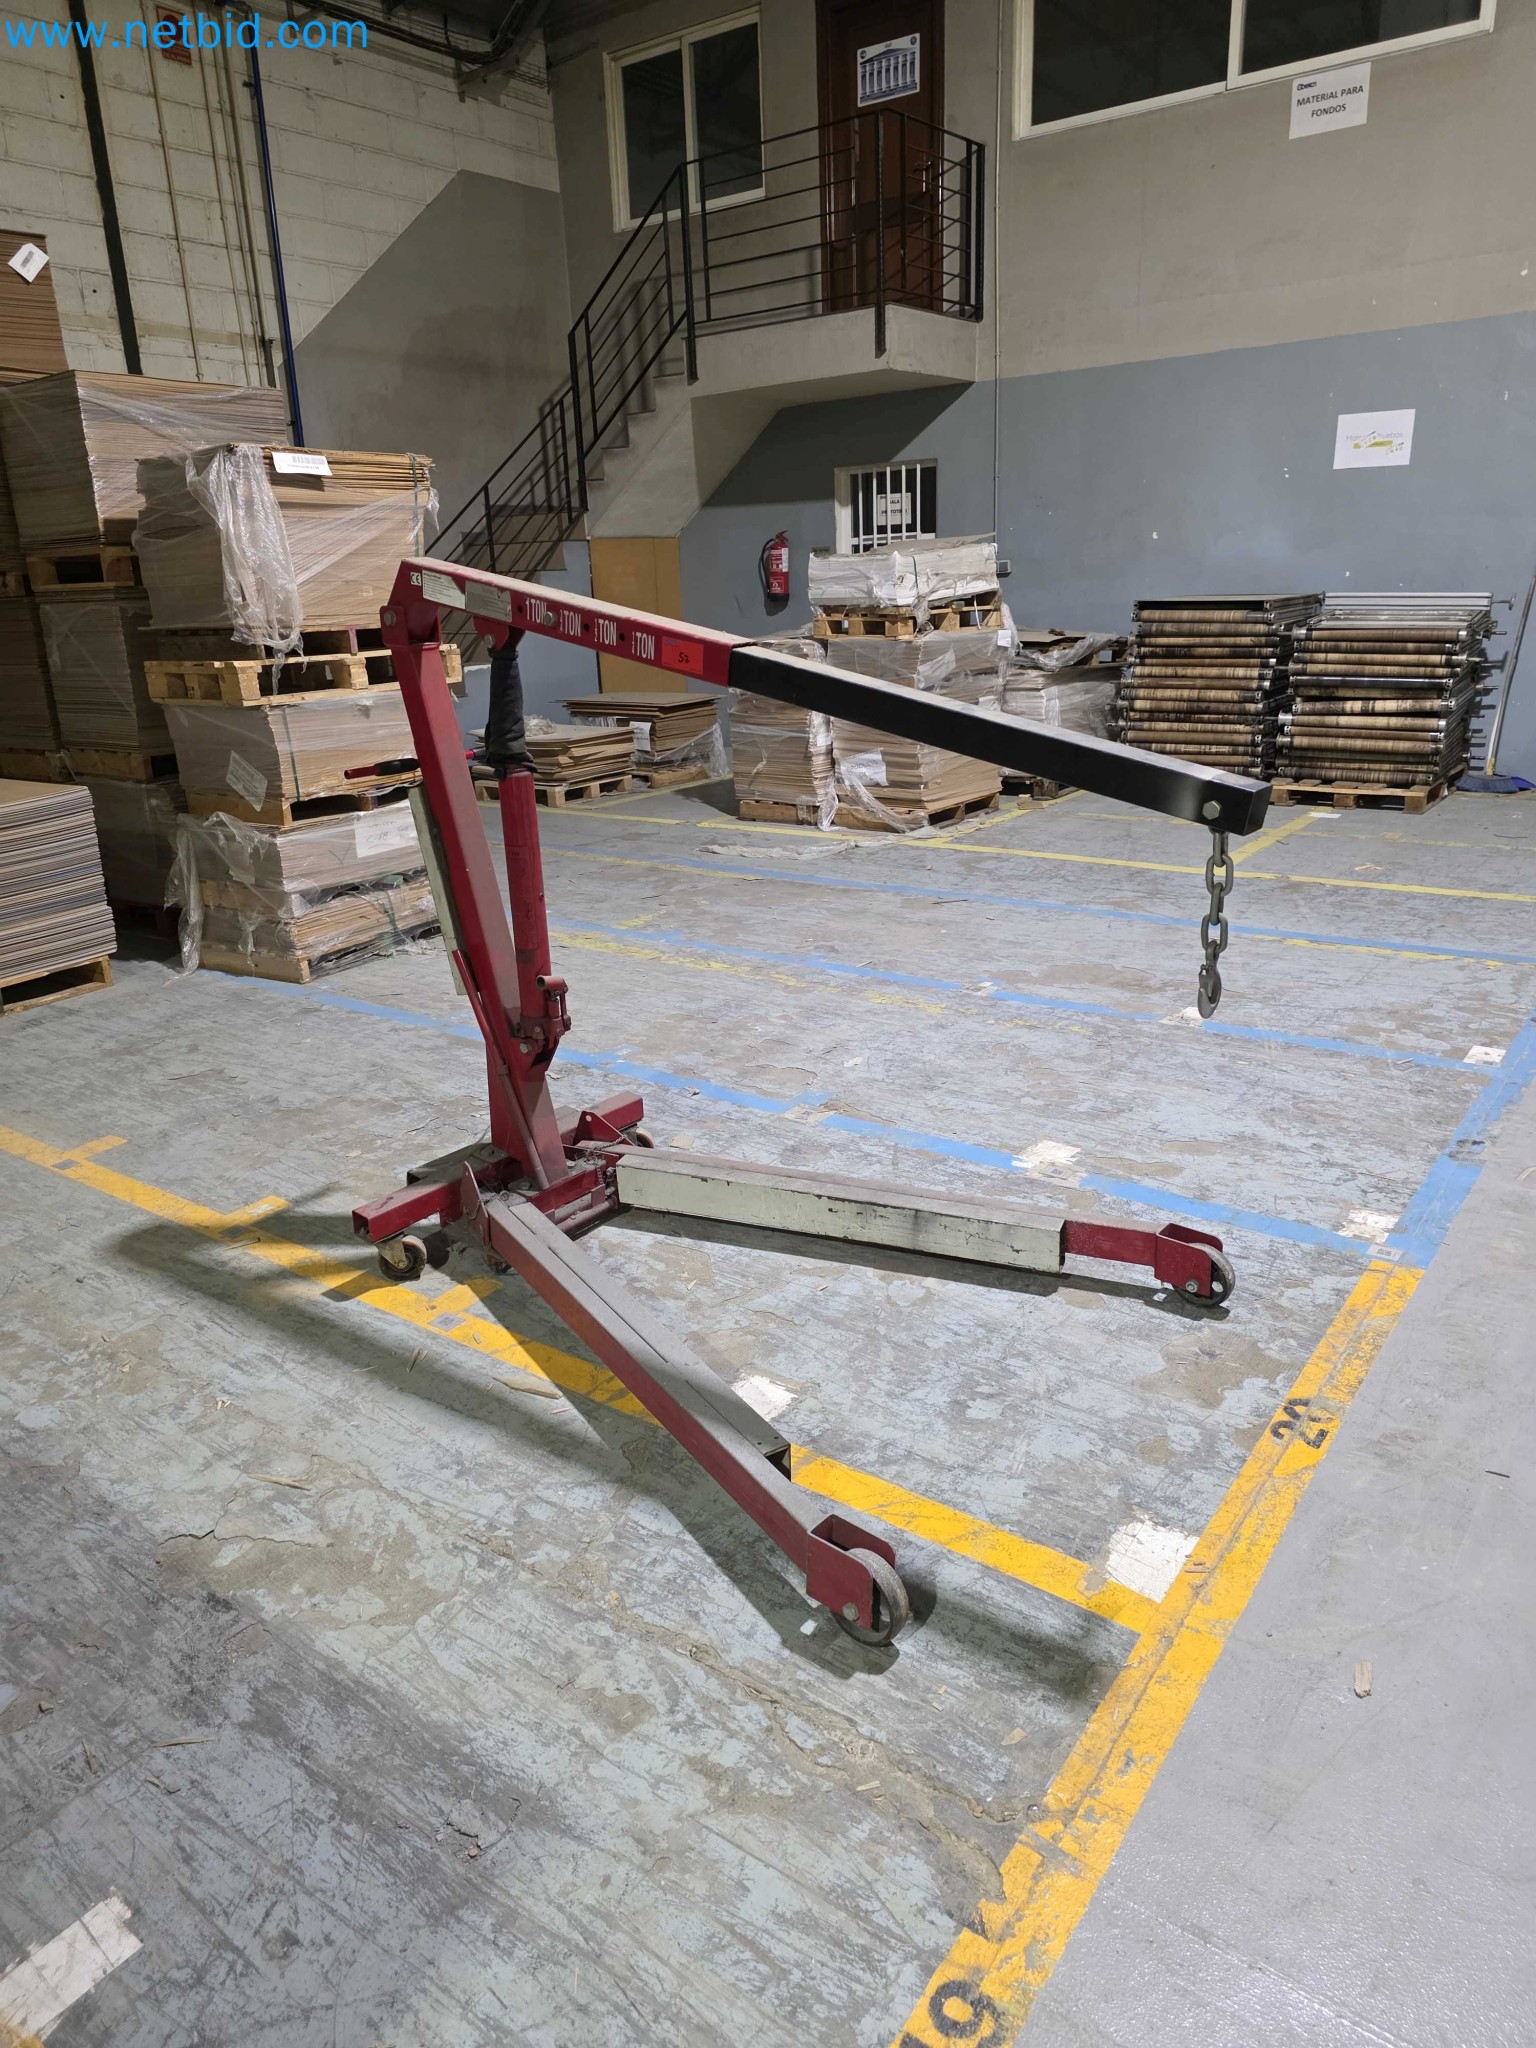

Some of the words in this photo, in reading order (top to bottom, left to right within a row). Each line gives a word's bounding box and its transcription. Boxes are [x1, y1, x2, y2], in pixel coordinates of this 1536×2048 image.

[1297, 91, 1339, 107] MATERIAL
[1341, 85, 1364, 97] PARA
[1311, 103, 1347, 118] FONDOS
[563, 610, 581, 637] TON
[598, 618, 617, 646] TON
[636, 631, 655, 660] TON
